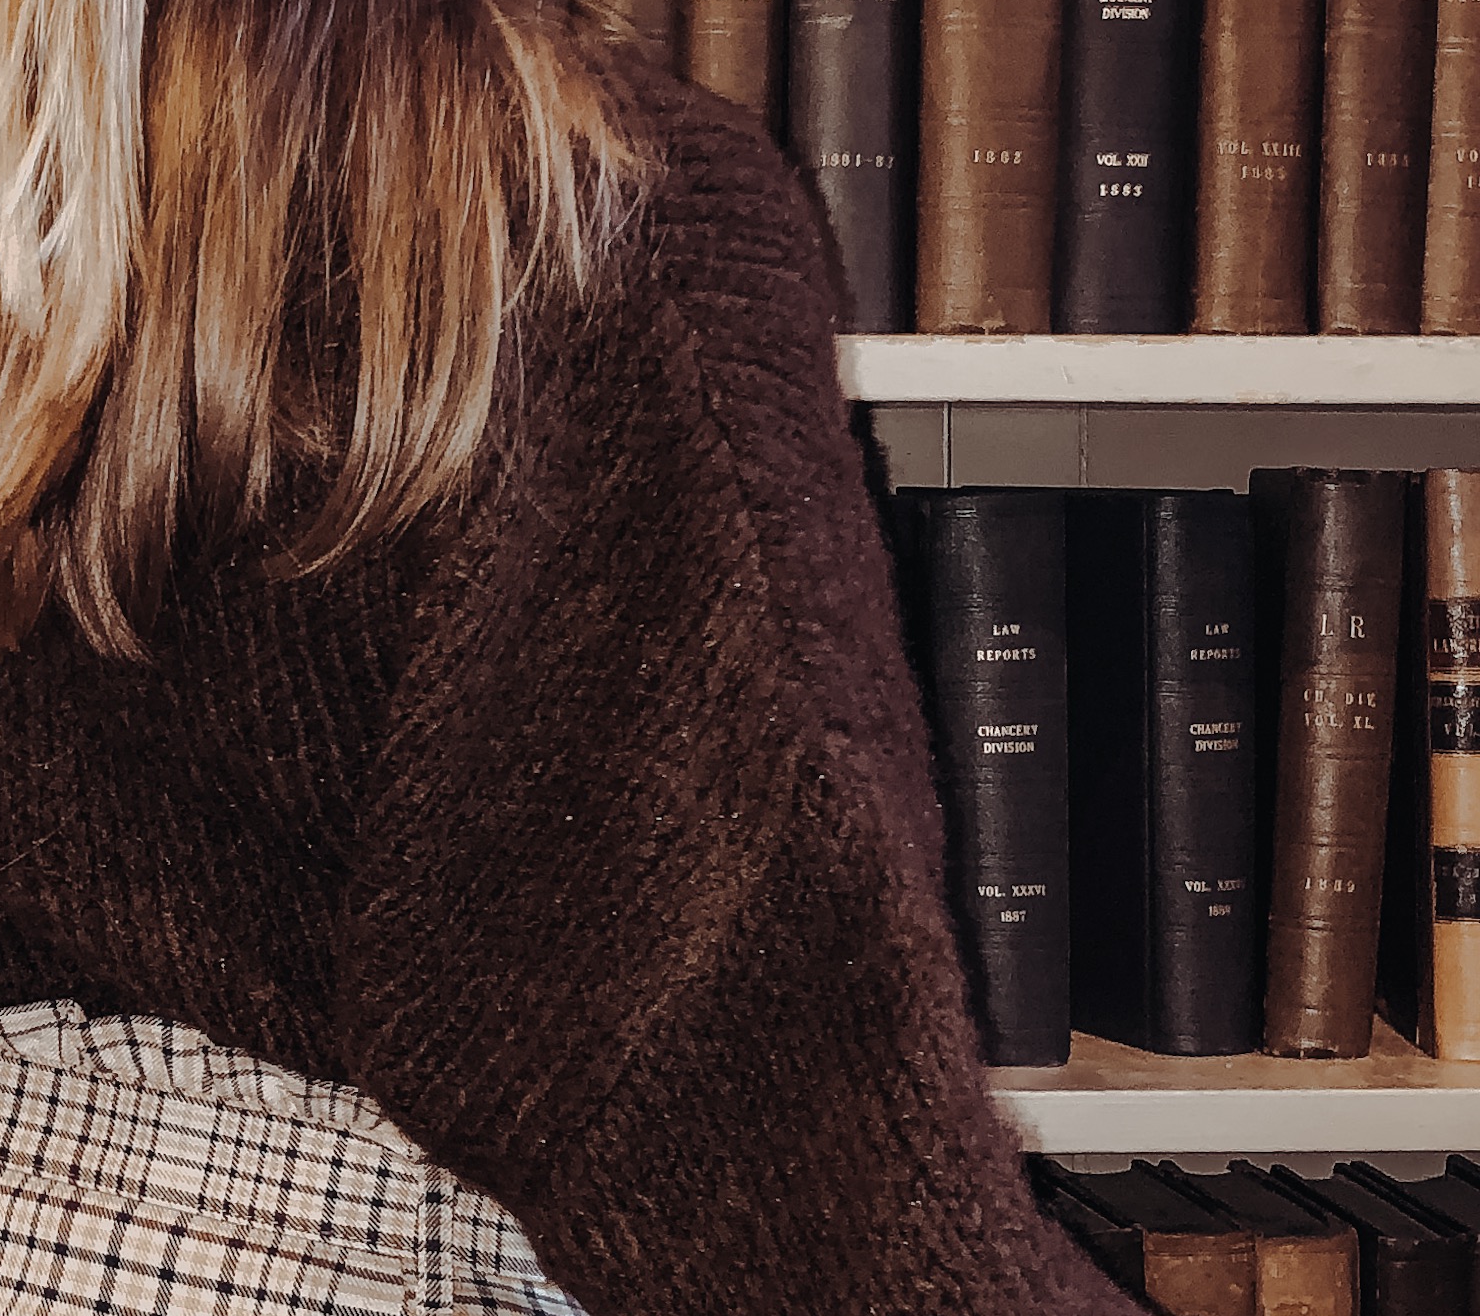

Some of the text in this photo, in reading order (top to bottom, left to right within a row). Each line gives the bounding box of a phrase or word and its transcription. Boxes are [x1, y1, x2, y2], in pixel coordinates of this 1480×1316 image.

[1102, 7, 1150, 19] DIVISION
[993, 624, 1020, 635] LAW
[977, 648, 1036, 661] REPORTS
[983, 742, 1034, 753] DIVISION
